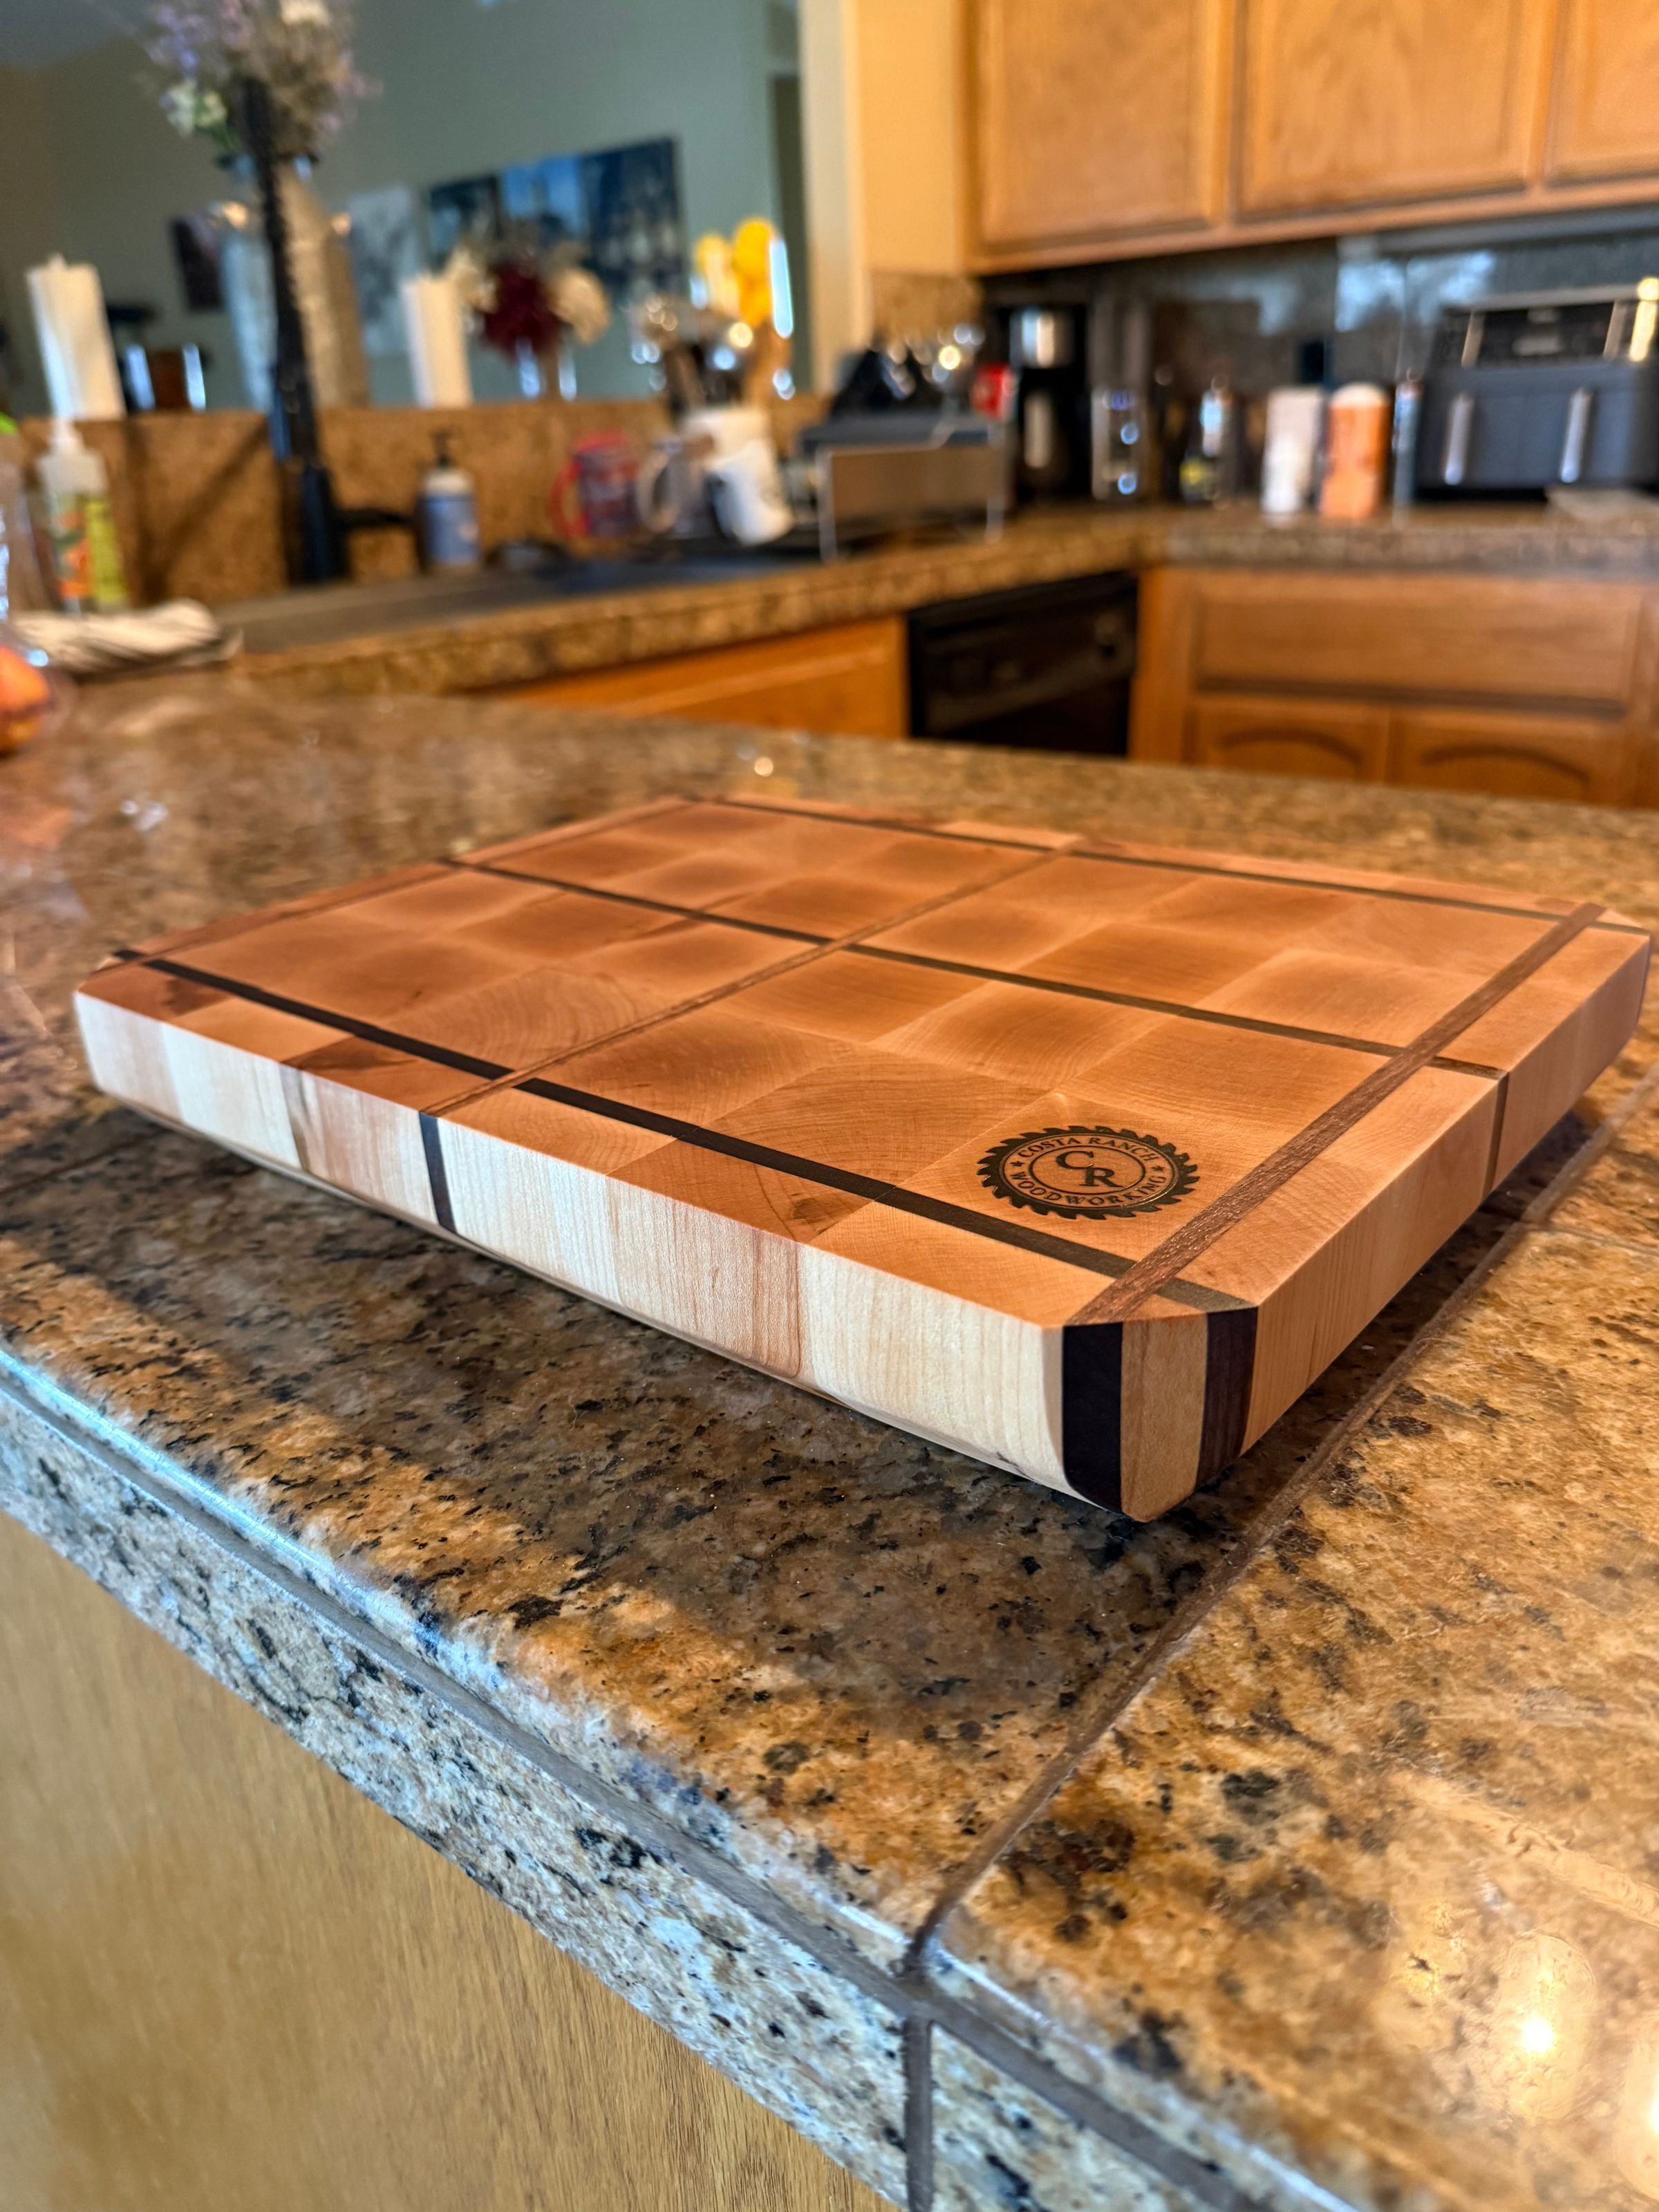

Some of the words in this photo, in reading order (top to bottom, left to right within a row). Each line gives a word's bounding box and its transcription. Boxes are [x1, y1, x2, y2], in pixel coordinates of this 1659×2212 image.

[1018, 1137, 1081, 1159] COSTA
[1087, 1137, 1159, 1162] RANCH
[1011, 1171, 1166, 1206] WOODWORKING
